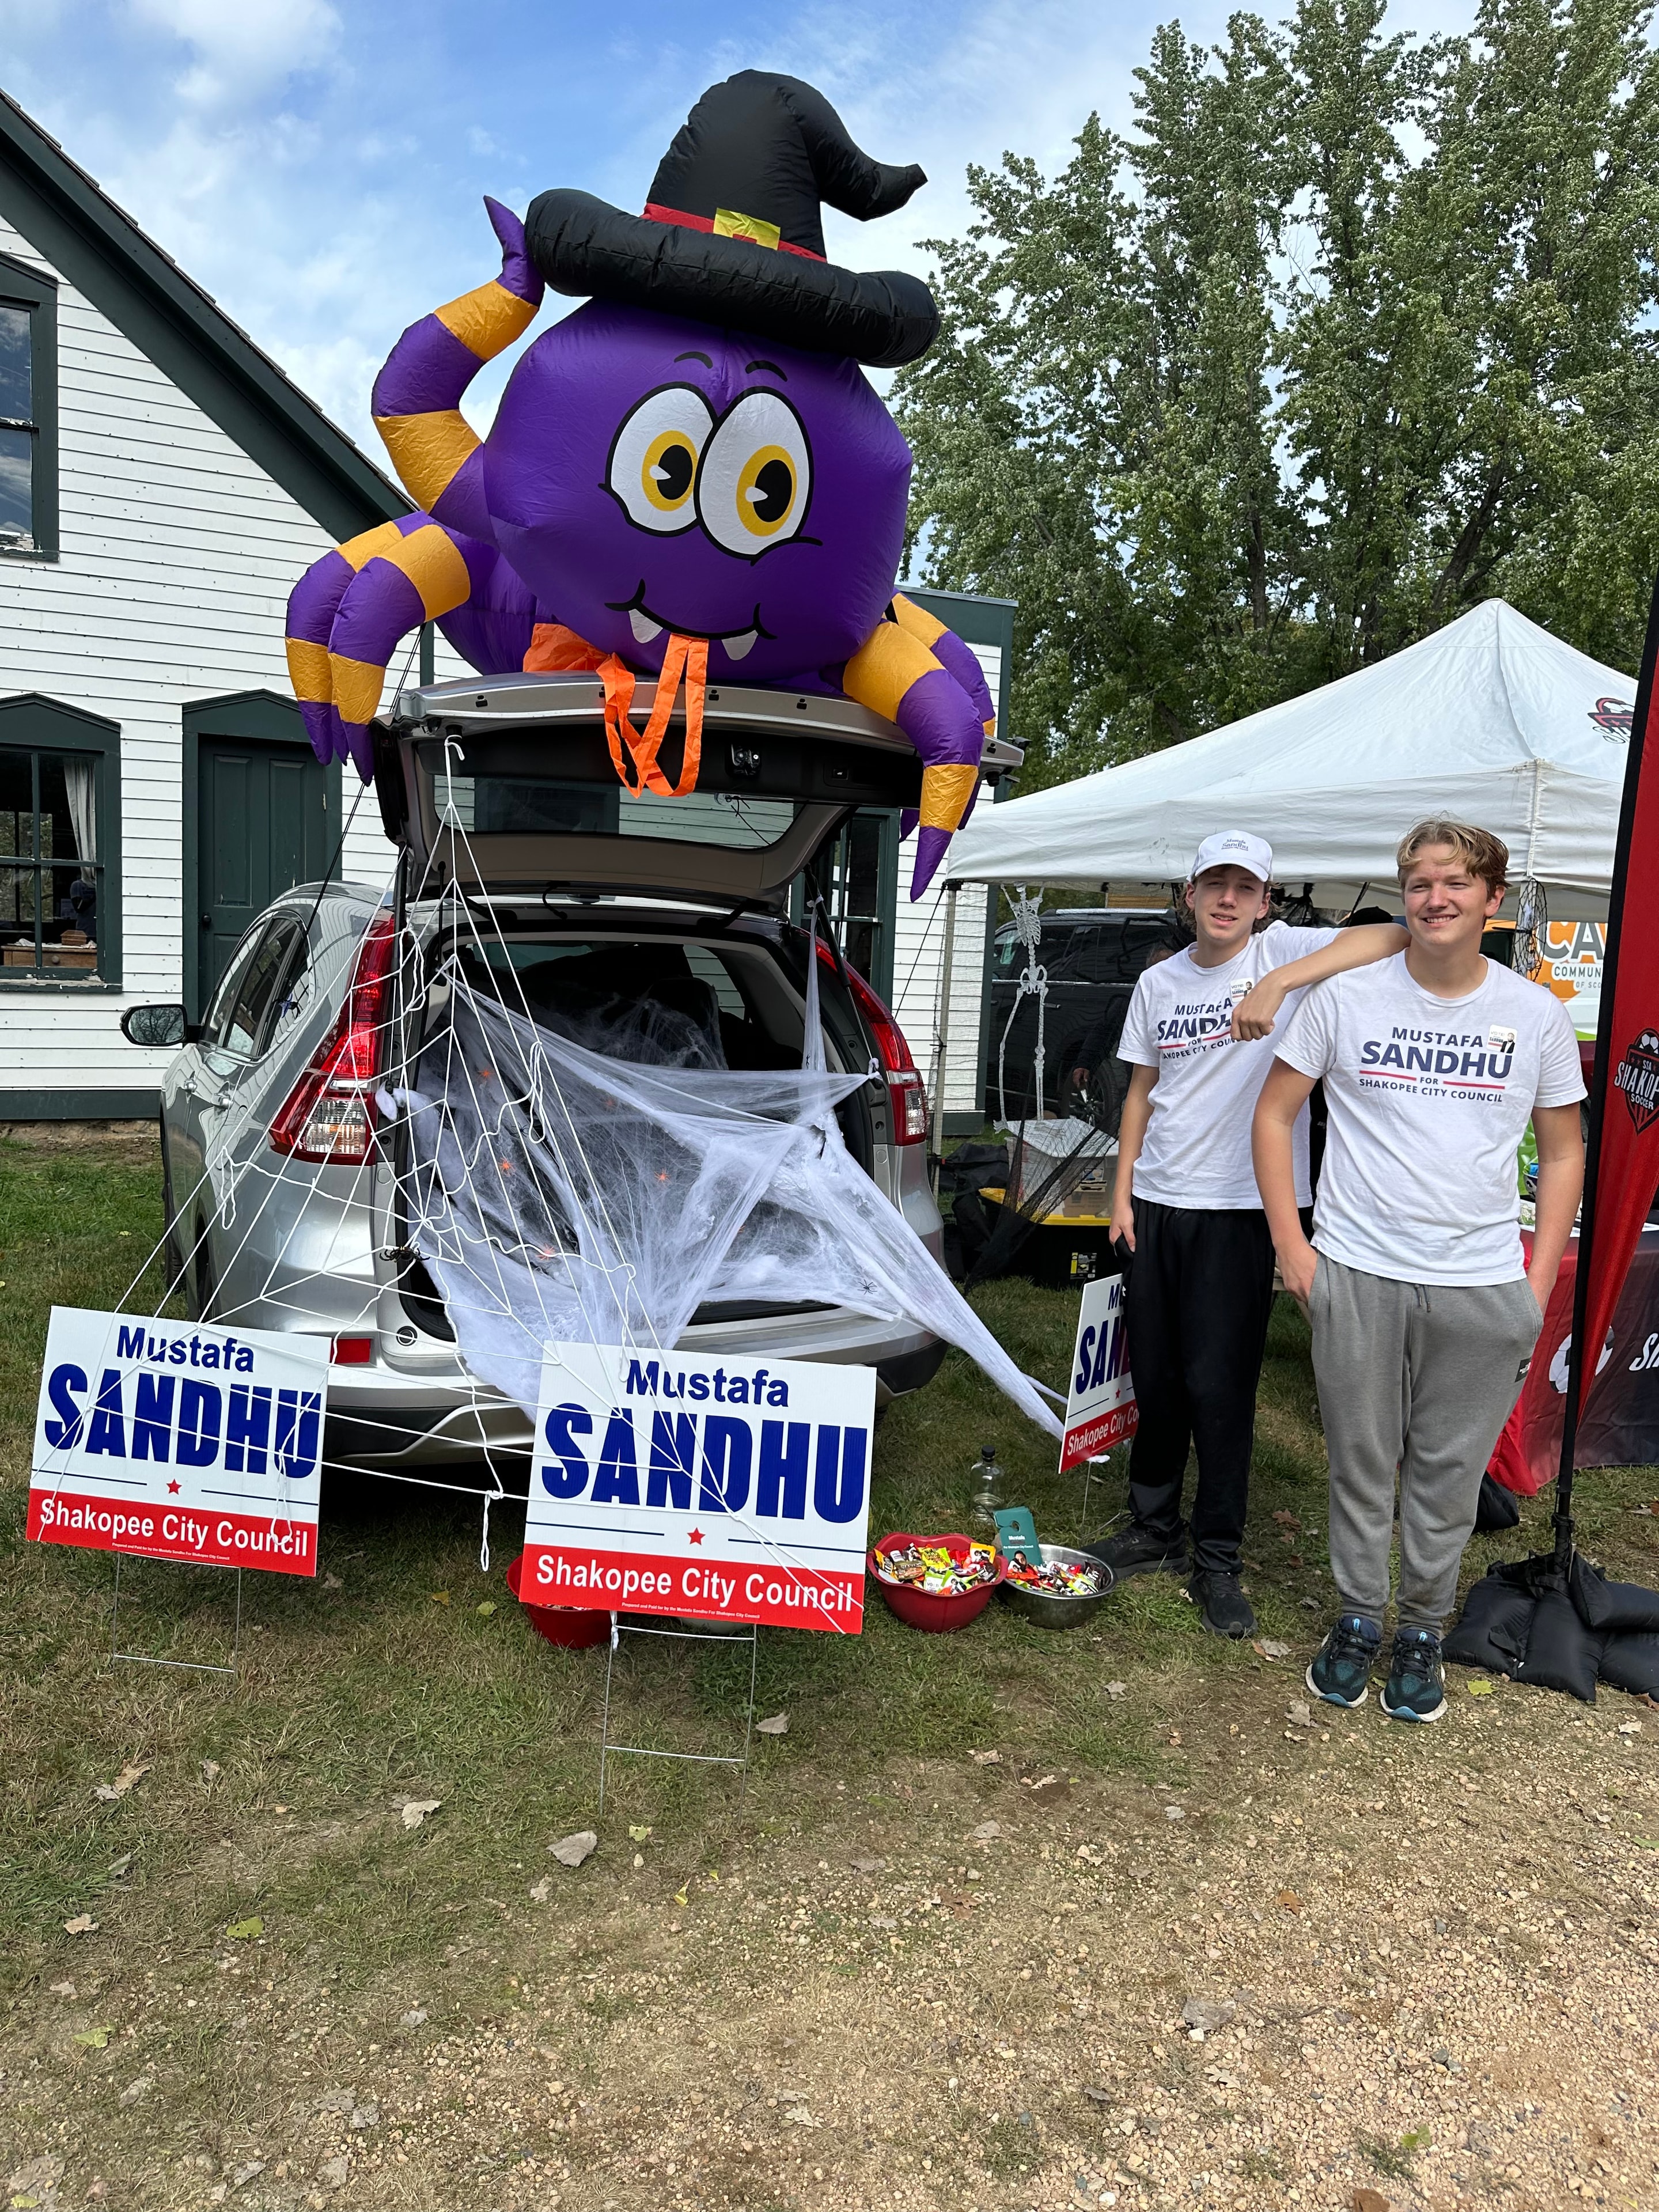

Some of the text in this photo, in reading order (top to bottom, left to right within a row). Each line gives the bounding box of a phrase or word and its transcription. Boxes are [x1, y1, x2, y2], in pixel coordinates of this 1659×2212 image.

[1539, 922, 1603, 960] CA
[1554, 966, 1601, 978] COMMUN
[1175, 997, 1233, 1016] MUSTAFA
[1158, 1014, 1232, 1041] SANDH
[1392, 1027, 1483, 1048] MUSTAFA
[1162, 1050, 1191, 1060] AKOPEE
[1210, 1037, 1236, 1049] COUN
[1361, 1040, 1513, 1079] SANDHU
[1643, 1059, 1652, 1071] SSA
[1359, 1078, 1503, 1103] SHAKOPEE CITY COUNCIL
[1419, 1077, 1439, 1085] FOR
[1614, 1061, 1659, 1101] SHAKOP
[1631, 1093, 1654, 1111] SOCCER
[116, 1325, 254, 1373] Mustafa
[1075, 1314, 1131, 1395] SAN
[626, 1359, 789, 1407] Mustafa
[44, 1363, 321, 1479] SANDHU
[1067, 1423, 1109, 1456] Shakopee
[1110, 1412, 1126, 1434] City
[1127, 1406, 1139, 1425] Co
[541, 1402, 868, 1523] SANDHU
[40, 1498, 308, 1556] Shakopee City Council
[536, 1554, 853, 1611] Shakopee City Council
